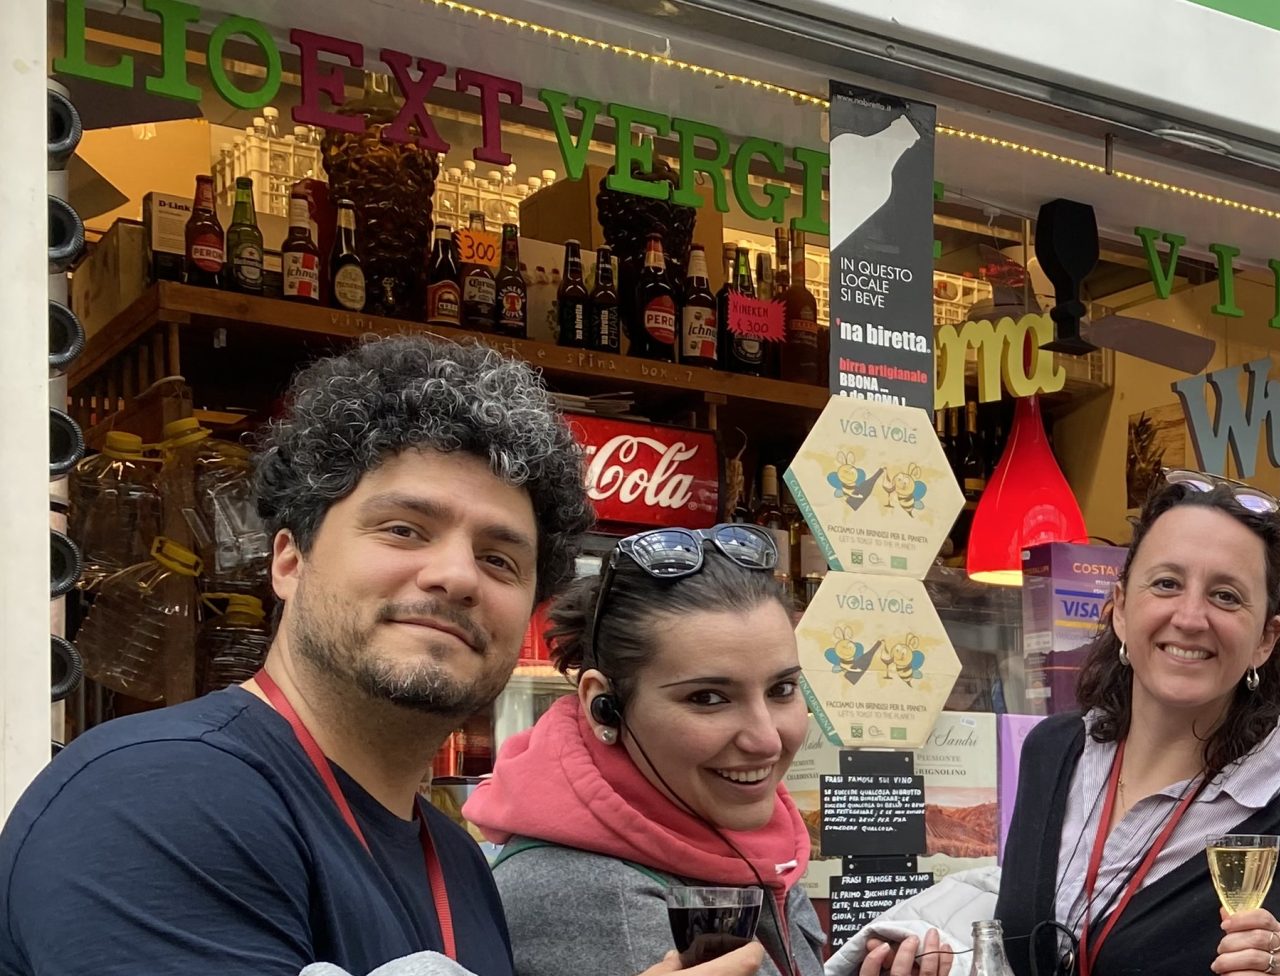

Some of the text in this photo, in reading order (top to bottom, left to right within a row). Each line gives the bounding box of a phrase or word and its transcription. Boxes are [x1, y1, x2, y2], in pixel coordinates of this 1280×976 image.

[290, 28, 522, 166] EXT
[538, 88, 831, 236] VERGI
[158, 199, 192, 212] D-Link
[192, 247, 223, 262] PERON
[464, 234, 496, 262] 300
[840, 256, 913, 282] IN QUESTO
[840, 272, 890, 294] LOCALE
[840, 288, 885, 308] SI BEVE
[866, 323, 931, 353] biretta.
[934, 313, 1066, 410] rra
[840, 418, 877, 438] Vola
[836, 594, 874, 611] Vola
[1061, 599, 1100, 618] VISA
[917, 754, 962, 763] PIEMONTE
[841, 876, 861, 885] FRASI
[866, 875, 893, 884] FAMOSE
[832, 891, 839, 899] IL
[840, 891, 861, 899] PRIMO
[861, 900, 892, 908] SECONDO
